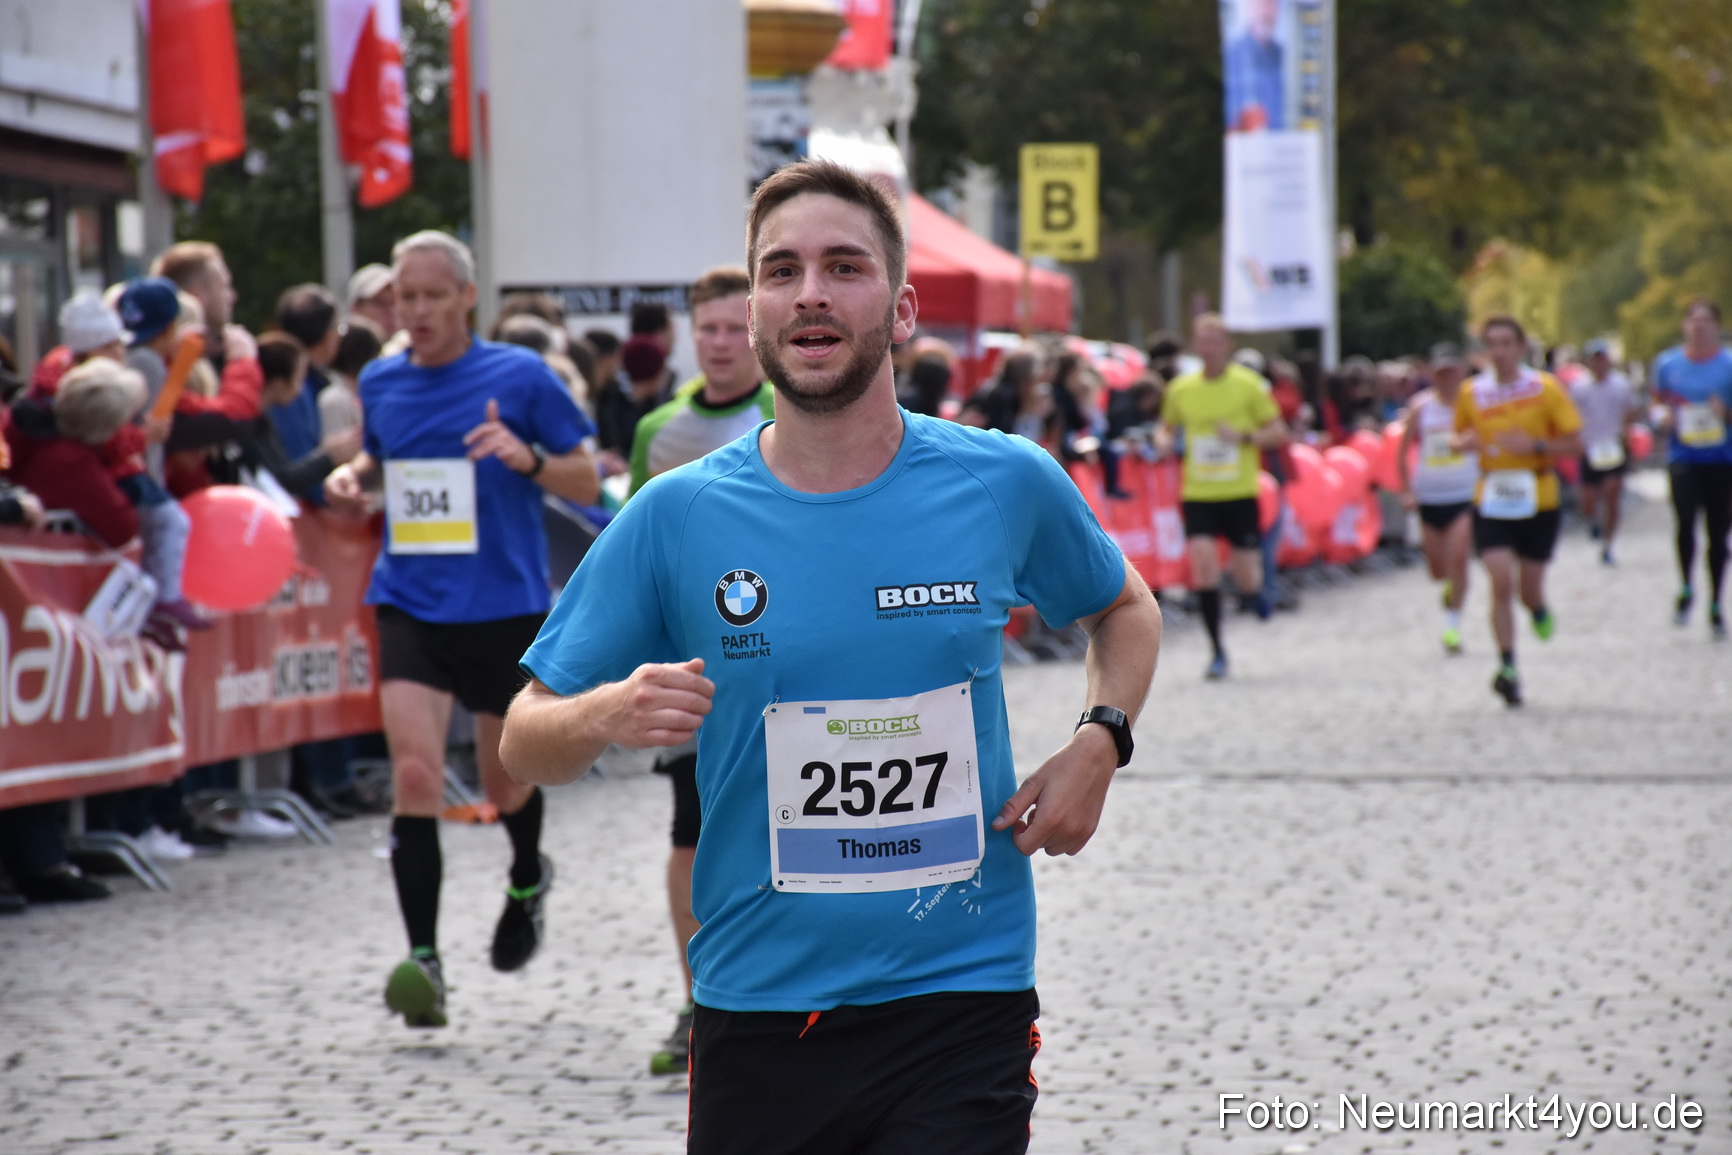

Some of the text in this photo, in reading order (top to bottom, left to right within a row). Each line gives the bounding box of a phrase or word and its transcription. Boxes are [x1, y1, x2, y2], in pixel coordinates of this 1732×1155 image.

[1041, 181, 1077, 232] B
[403, 489, 450, 517] 304
[719, 571, 763, 591] BMW
[875, 581, 981, 611] BOCK
[876, 607, 982, 621] inspired by smart concepts
[721, 632, 770, 650] PARTL
[724, 647, 771, 660] Neumarkt
[848, 714, 920, 734] BOCK
[801, 751, 948, 817] 2527
[781, 809, 789, 820] C
[837, 838, 922, 859] Thomas
[914, 909, 928, 921] 17.
